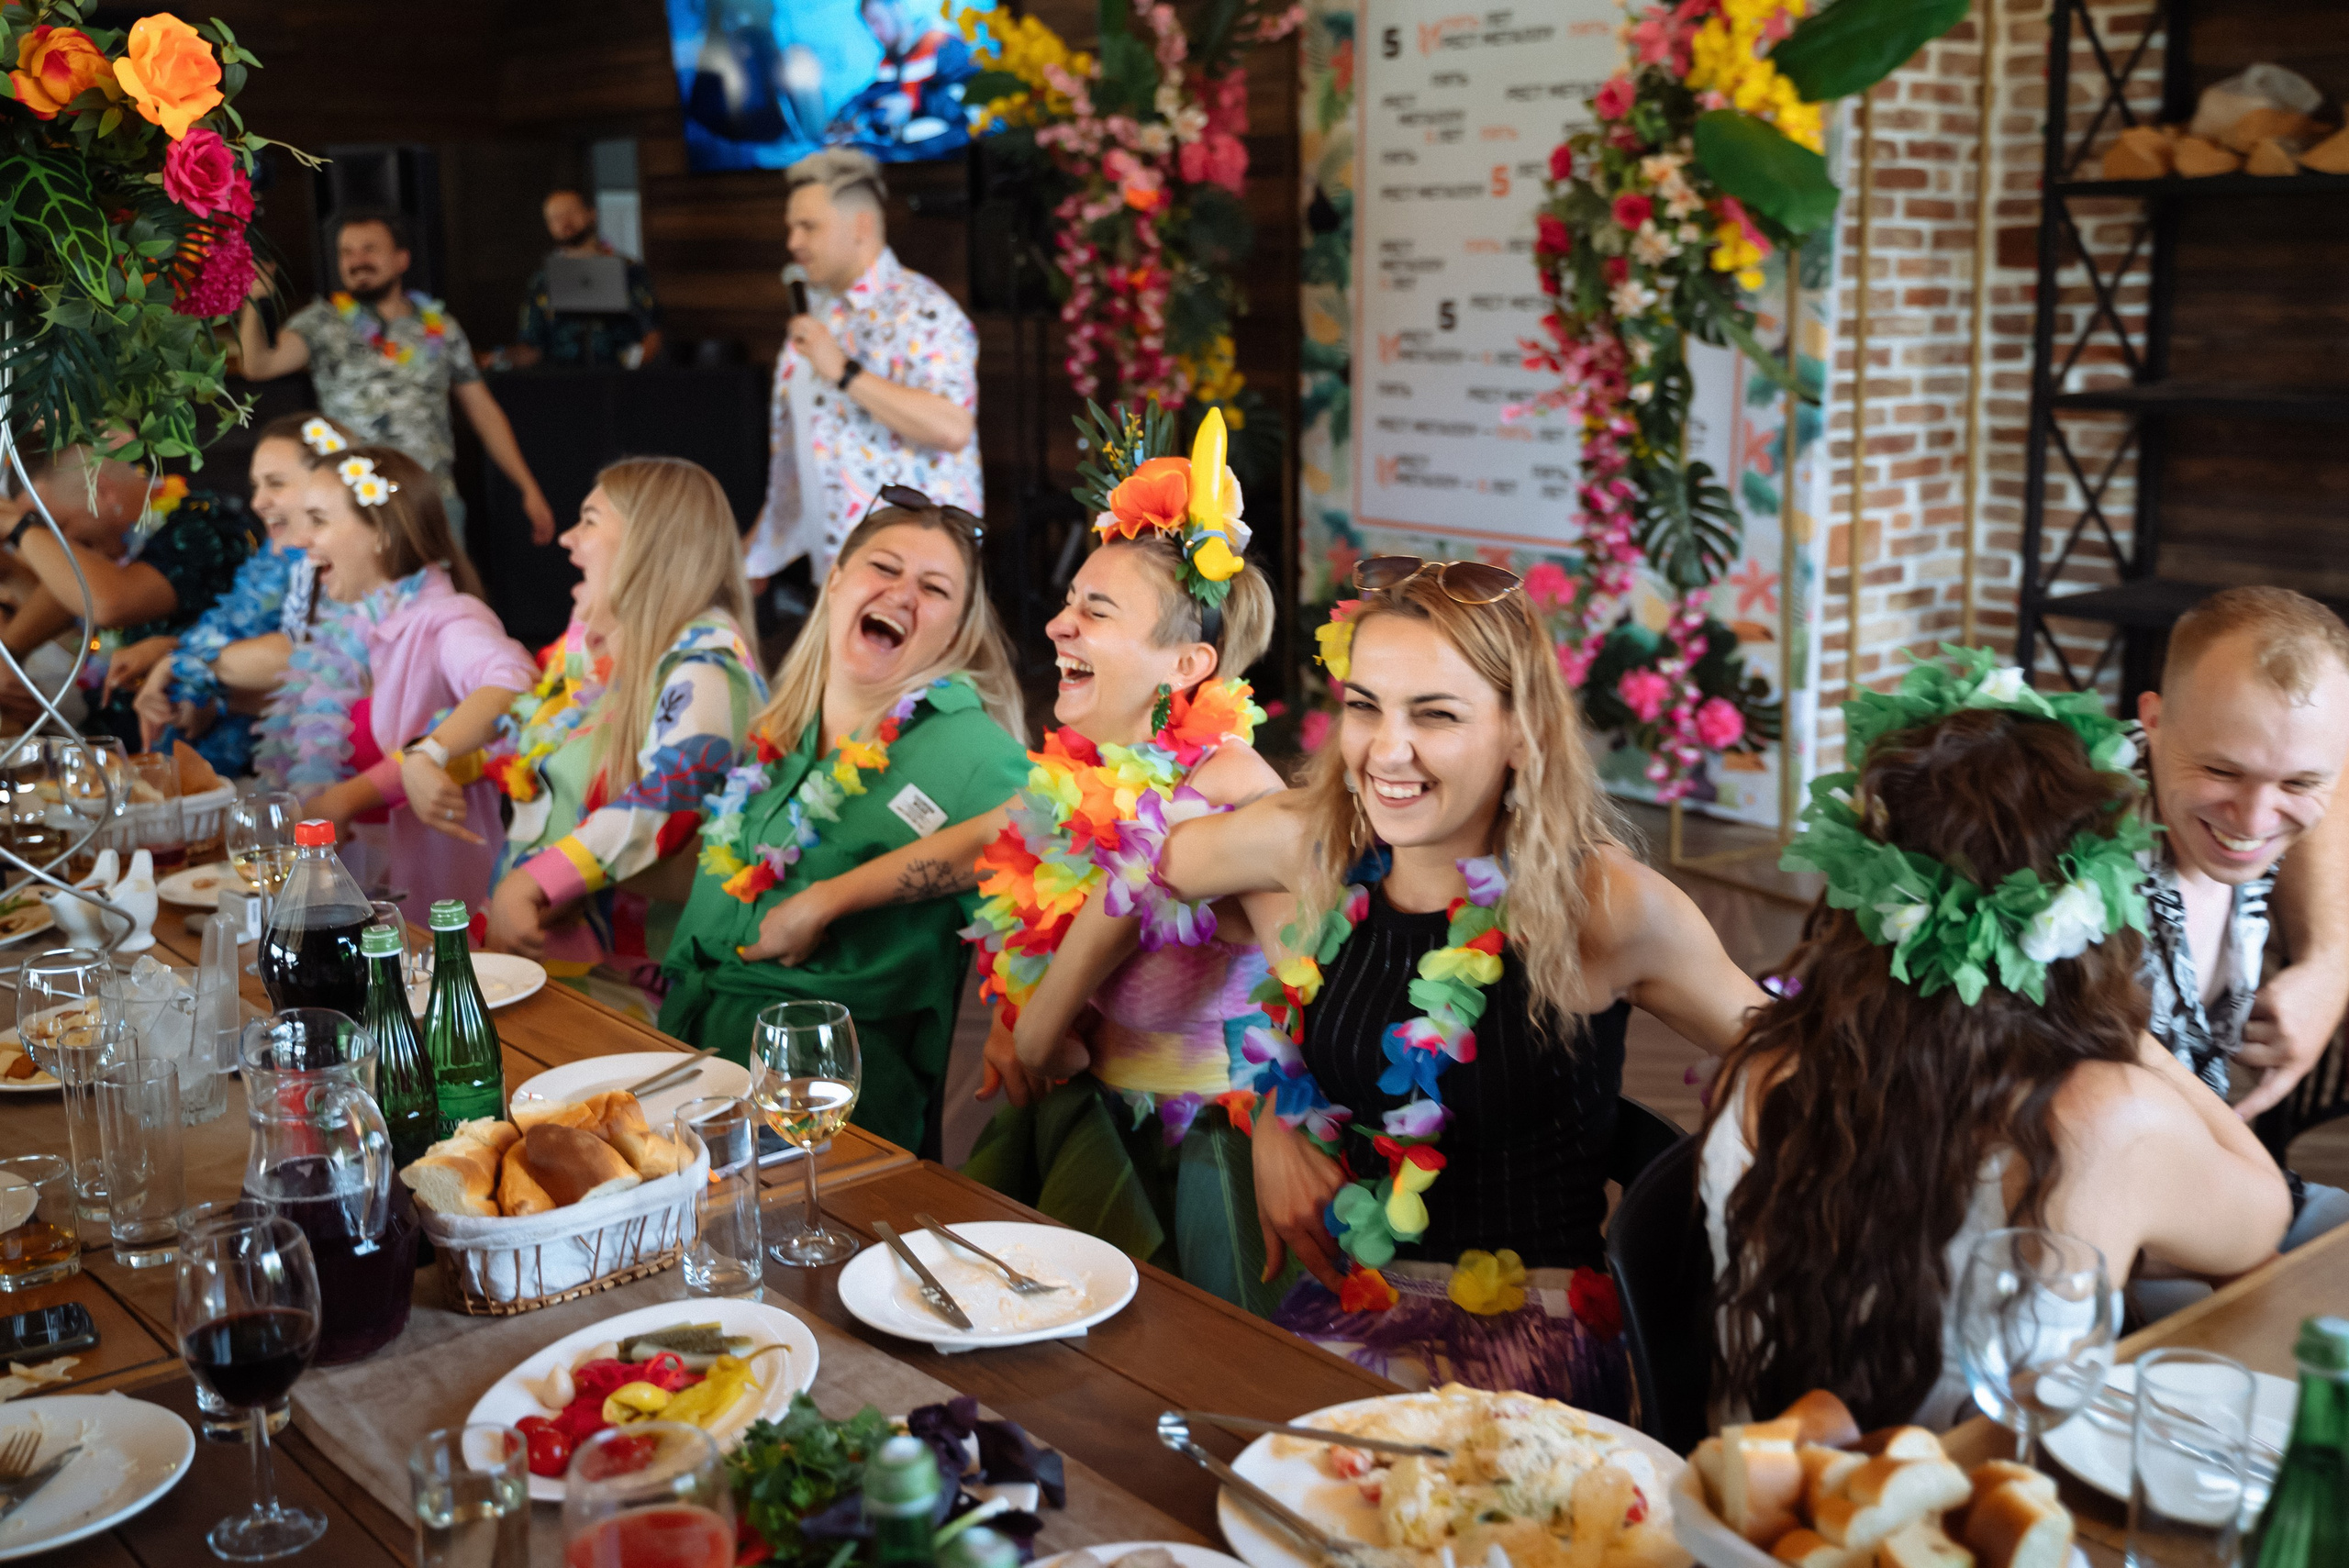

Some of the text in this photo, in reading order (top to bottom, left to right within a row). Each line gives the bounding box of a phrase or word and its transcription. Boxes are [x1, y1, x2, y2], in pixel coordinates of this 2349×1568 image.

[1383, 27, 1401, 59] 5
[1491, 164, 1509, 197] 5
[1439, 299, 1456, 331] 5
